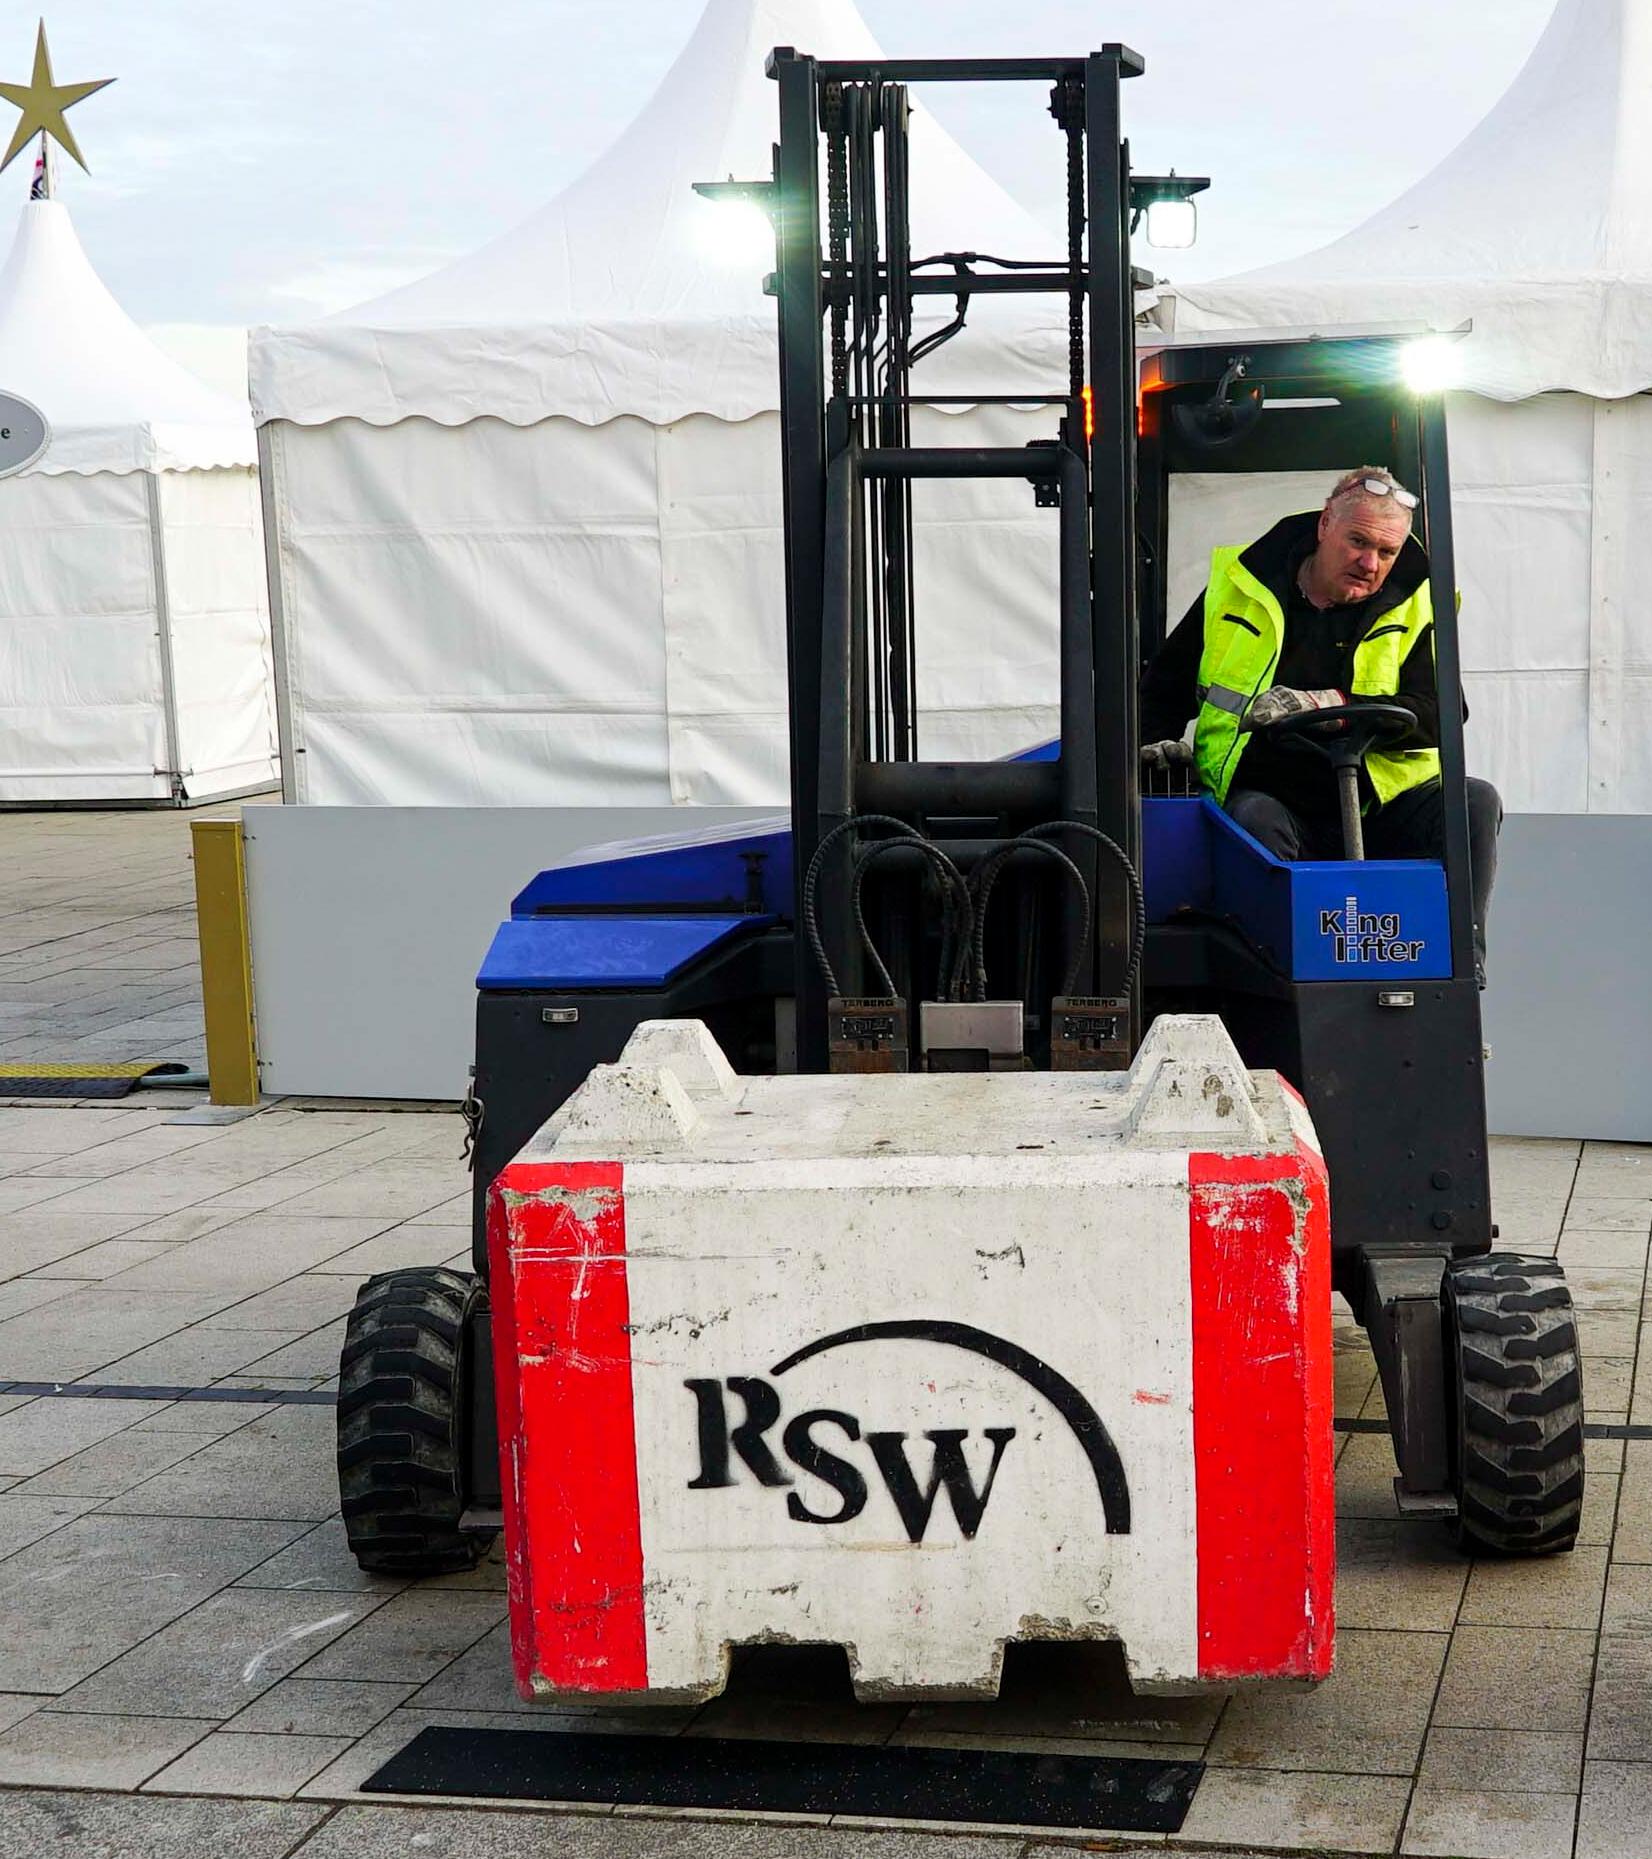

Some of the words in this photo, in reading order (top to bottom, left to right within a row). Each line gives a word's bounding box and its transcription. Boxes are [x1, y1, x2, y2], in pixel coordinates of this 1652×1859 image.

[1319, 896, 1401, 940] King
[1334, 935, 1426, 964] lifter
[683, 1375, 1017, 1544] RSW
